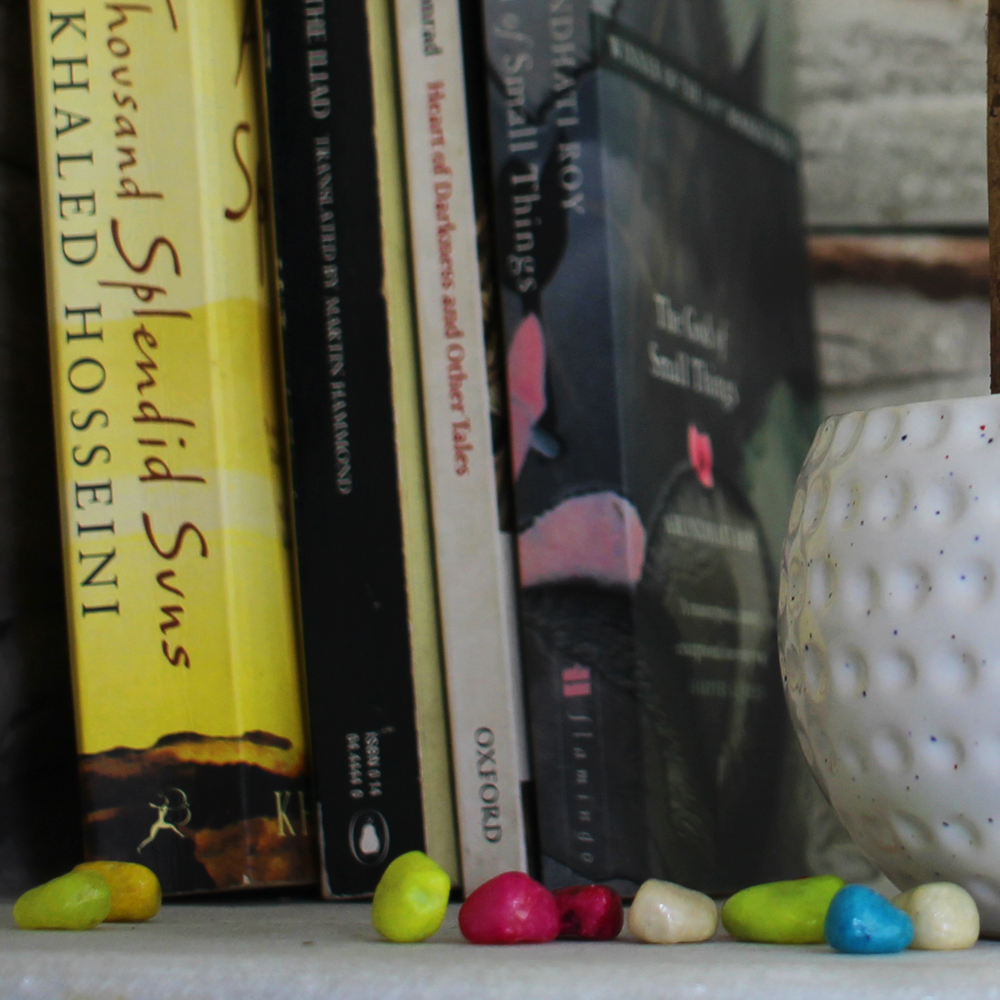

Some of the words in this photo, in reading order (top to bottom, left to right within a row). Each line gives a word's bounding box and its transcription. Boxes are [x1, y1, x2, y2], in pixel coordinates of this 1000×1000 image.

[493, 12, 534, 51] of
[306, 48, 332, 120] ILIAD
[427, 79, 447, 147] Heart
[502, 52, 538, 154] Small
[49, 9, 99, 268] KHALED
[431, 151, 454, 175] of
[557, 142, 585, 216] ROY
[434, 180, 457, 290] Darkness
[506, 160, 544, 295] Things
[98, 217, 206, 484] Splendid
[324, 296, 346, 376] MARTIN
[442, 294, 465, 339] and
[446, 343, 469, 413] Other
[64, 305, 120, 619] HOSSEINI
[329, 380, 353, 495] HAMMOND
[451, 415, 474, 477] Tales
[142, 510, 209, 670] Suns
[364, 731, 381, 766] ISBN
[473, 725, 503, 845] OXFORD
